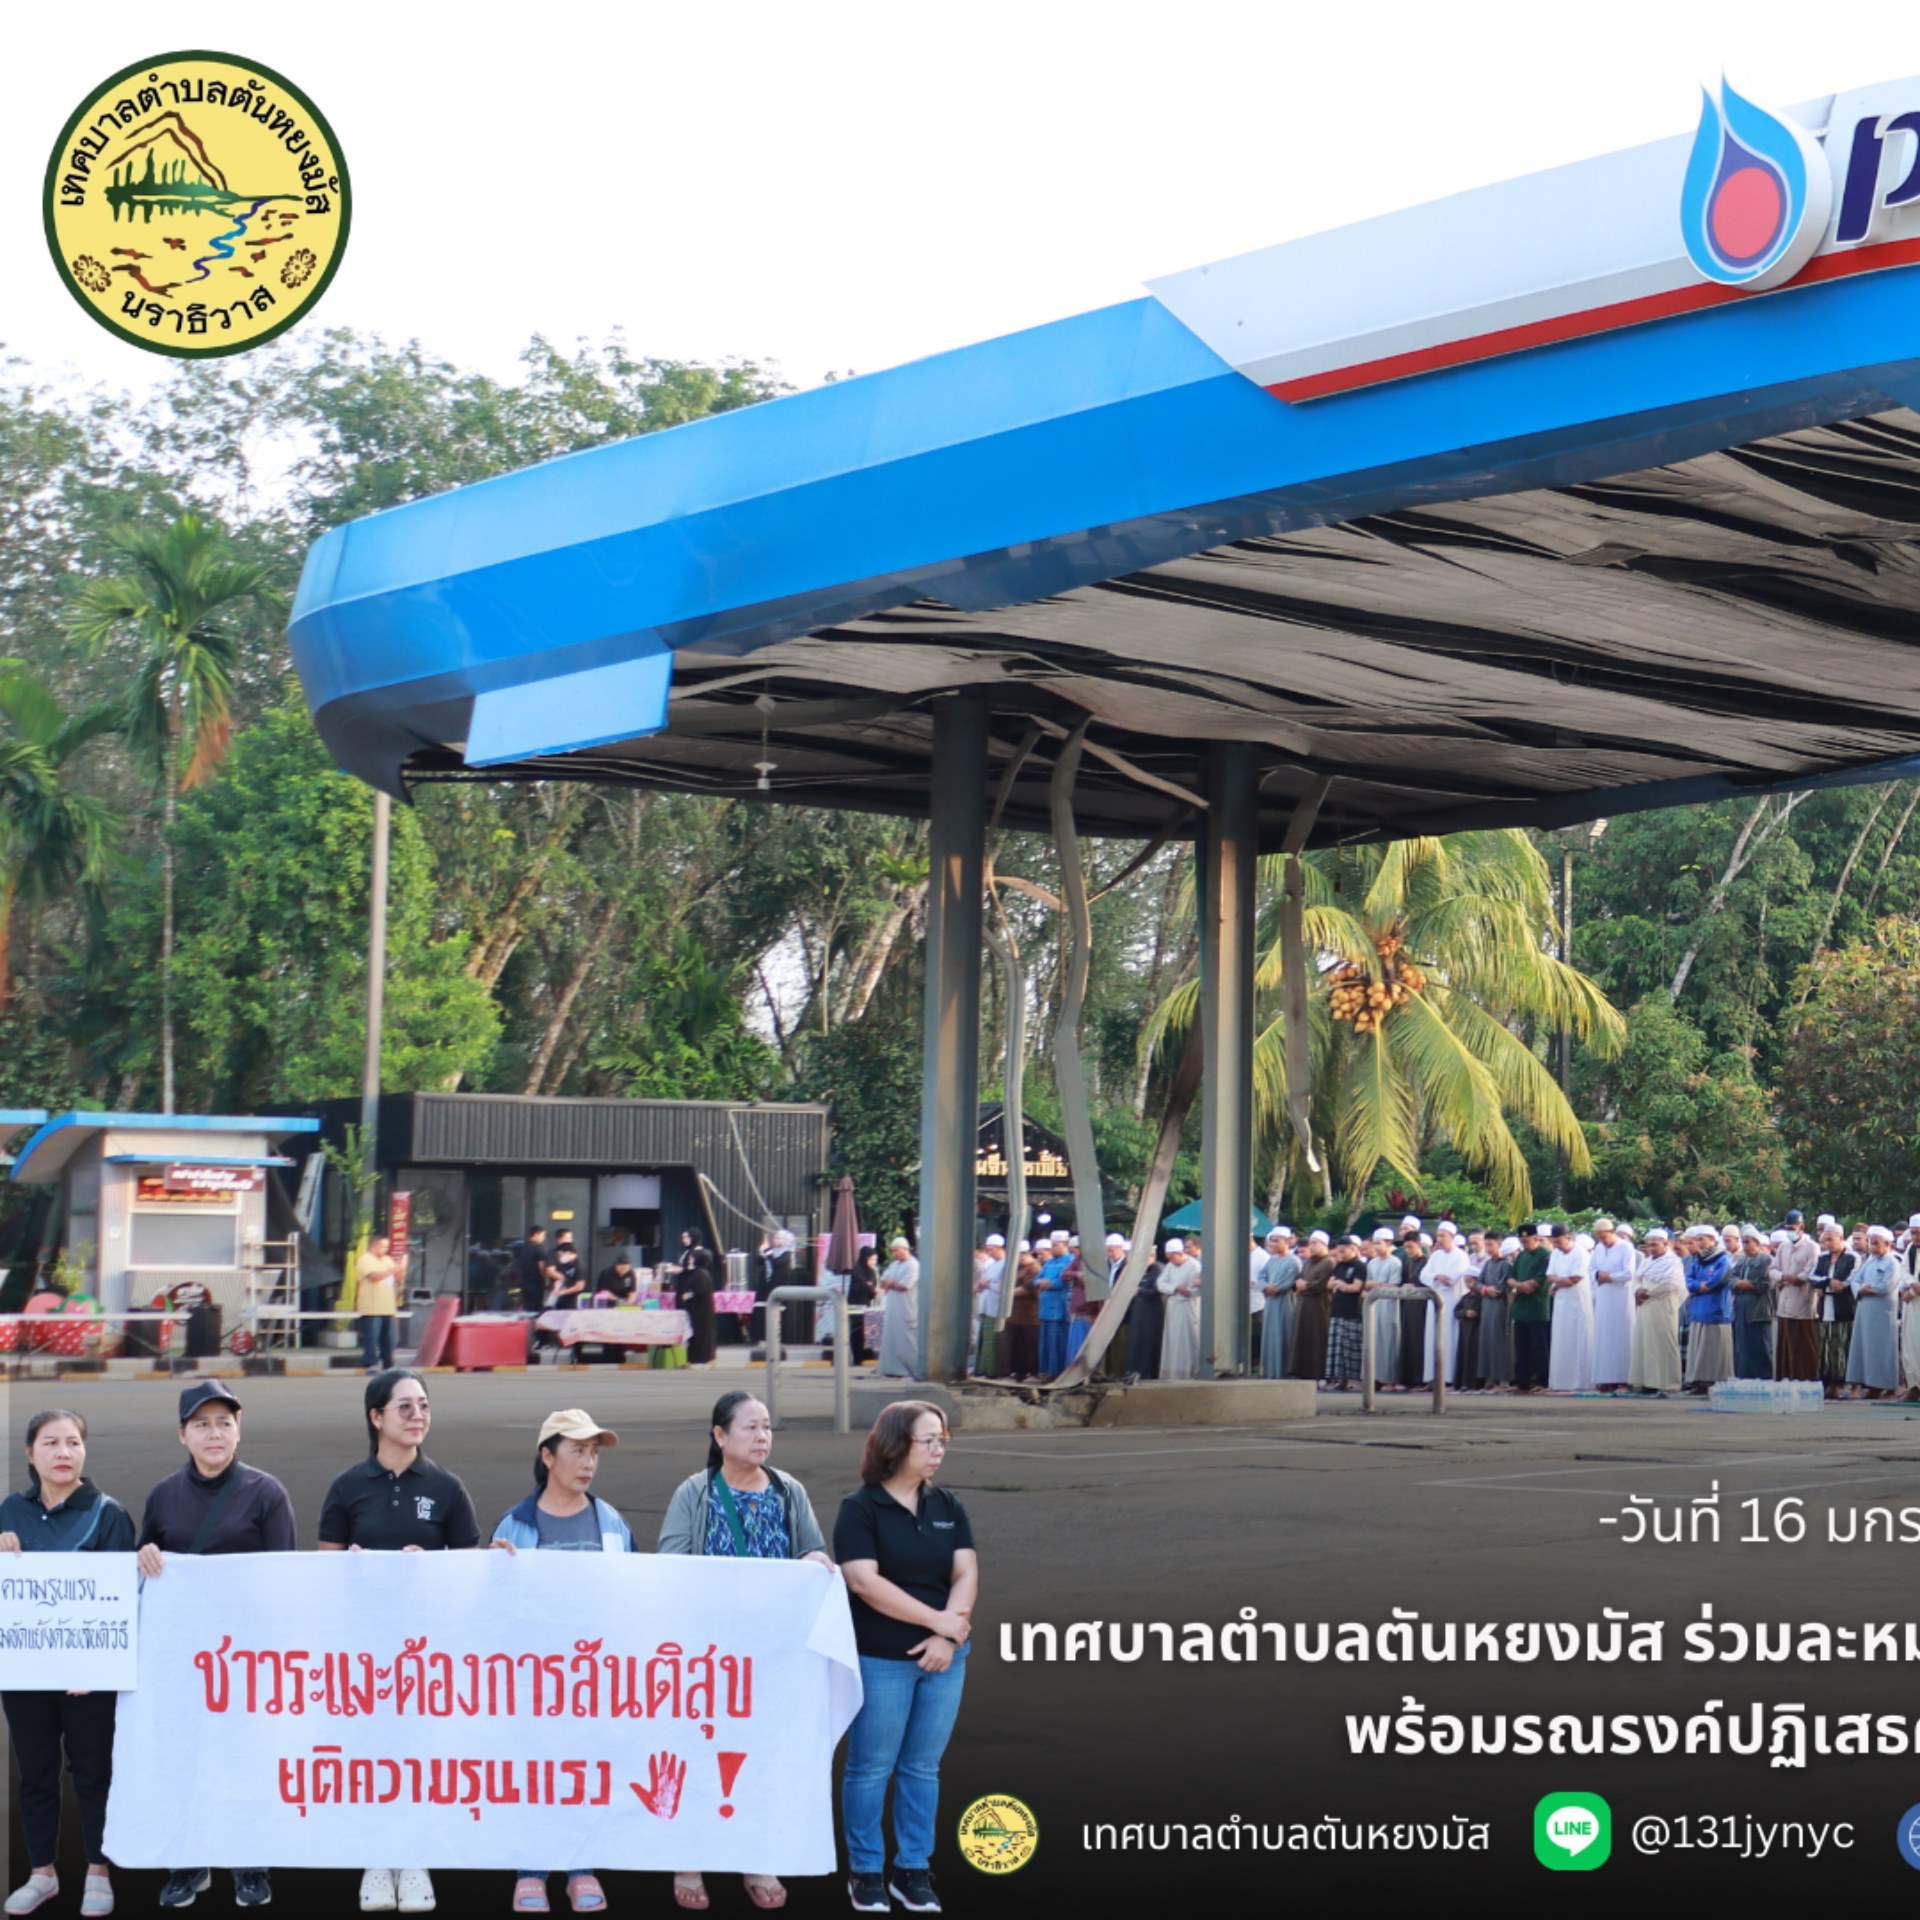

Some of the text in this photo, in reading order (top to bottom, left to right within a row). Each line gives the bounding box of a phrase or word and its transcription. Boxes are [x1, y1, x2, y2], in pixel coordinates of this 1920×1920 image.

[278, 1744, 611, 1820] ยุติความรุนแรง
